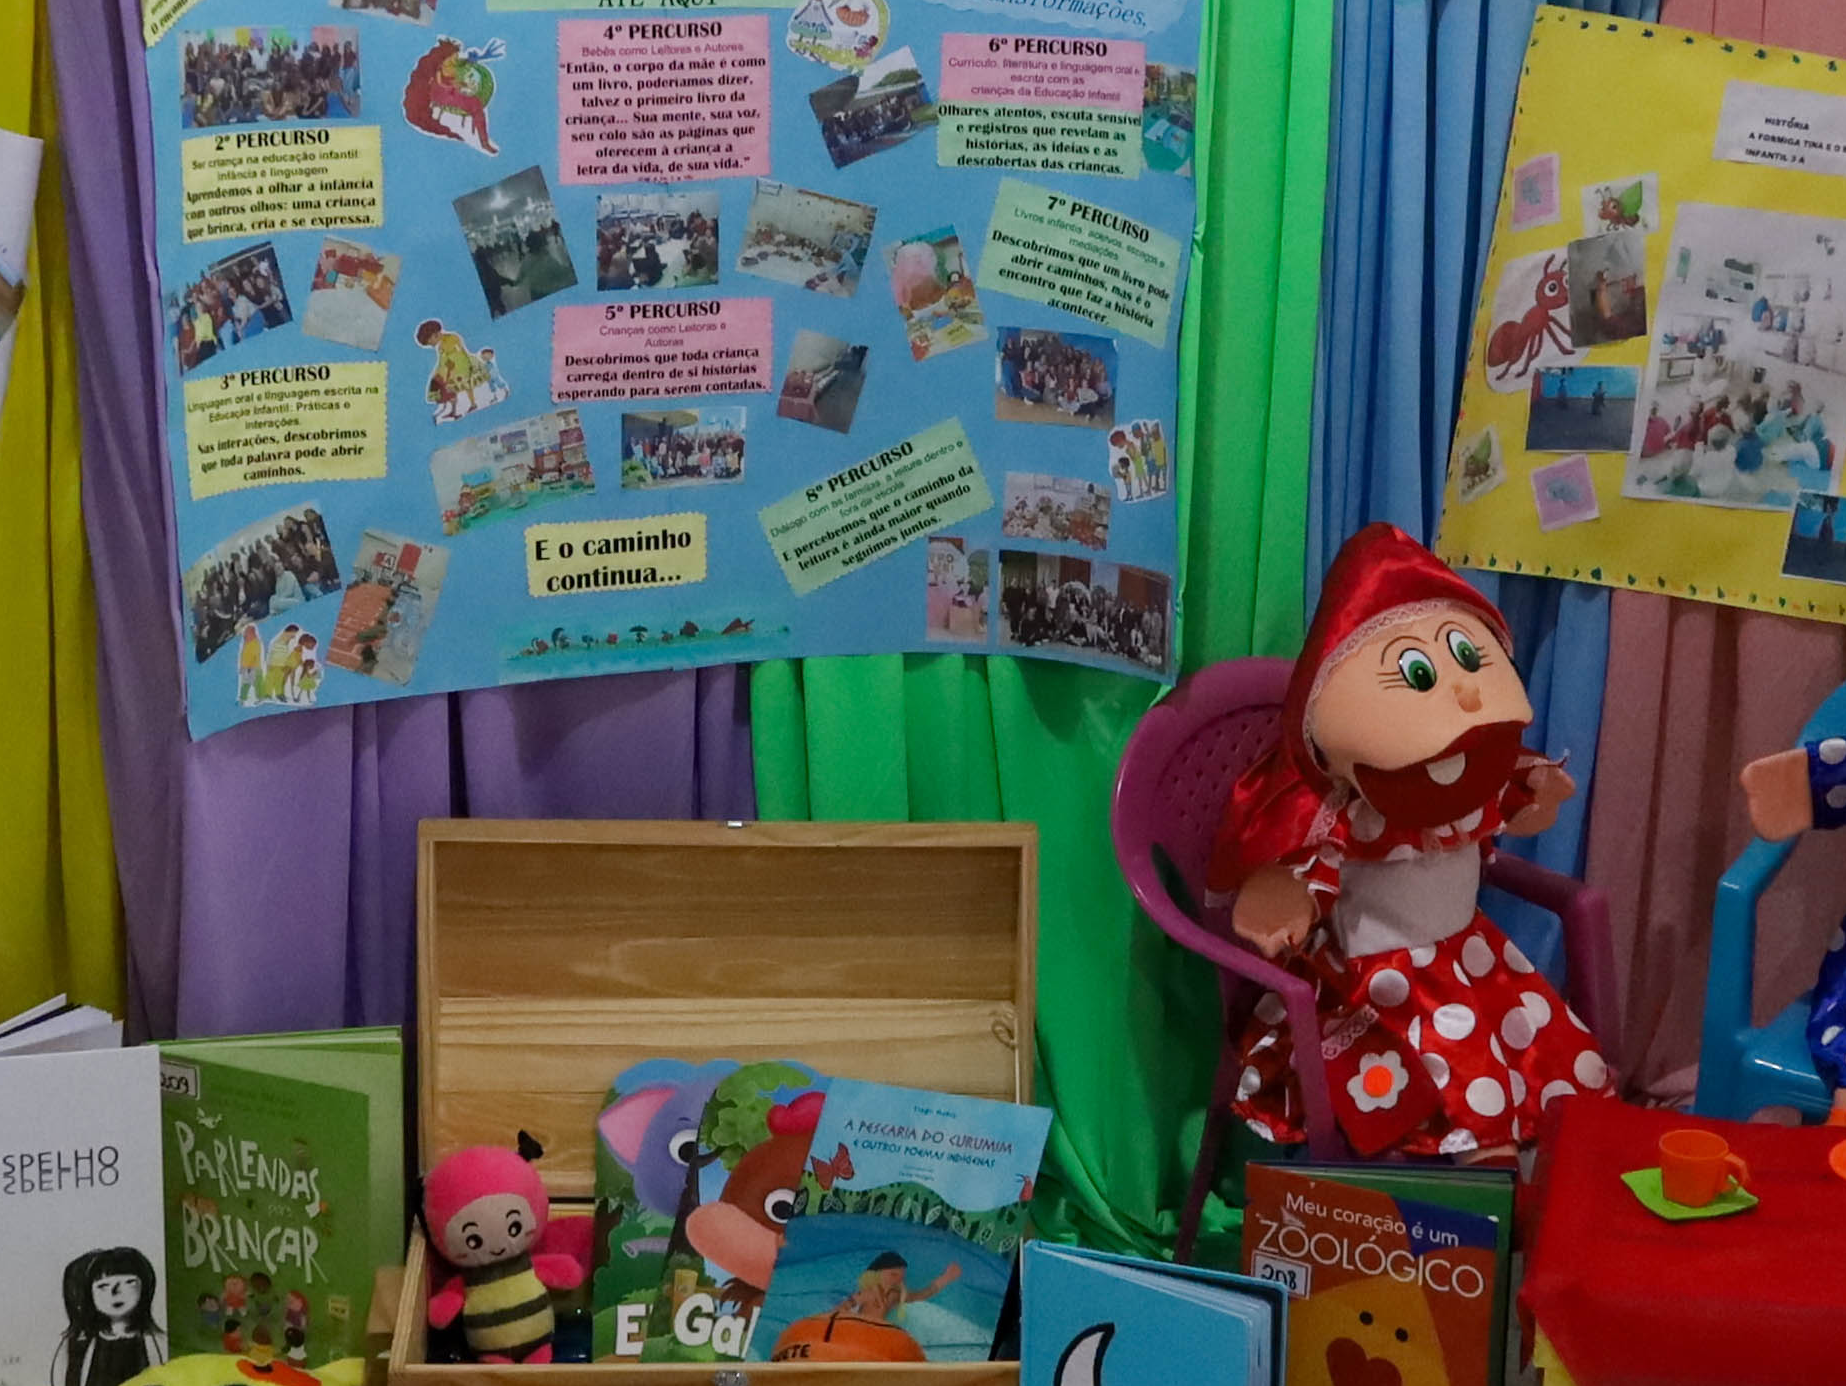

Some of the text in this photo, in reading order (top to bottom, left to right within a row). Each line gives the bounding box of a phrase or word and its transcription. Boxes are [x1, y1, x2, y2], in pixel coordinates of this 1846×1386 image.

[604, 22, 723, 40] 4º PERCURSO
[989, 38, 1107, 57] 6º PERCURSO
[236, 129, 330, 149] PERCURSO
[1748, 132, 1755, 140] A
[1758, 133, 1801, 147] FORMIGA
[1764, 117, 1810, 131] HISTÓRIA
[1745, 148, 1788, 161] INFANTIL
[1797, 156, 1805, 164] A
[1047, 196, 1149, 242] 7º PERCURSO
[630, 301, 721, 319] PERCURSO
[805, 441, 913, 503] 8º PERCURSO
[535, 526, 692, 561] E o caminho
[545, 563, 681, 594] continua...
[845, 1120, 1013, 1155] A PESCARIA DO CURUMIM
[175, 1120, 320, 1219] PARLENDAS
[1285, 1191, 1460, 1248] Meu coração é um
[182, 1199, 328, 1284] BRINCAR
[1257, 1219, 1485, 1298] ZOOLÓGICO
